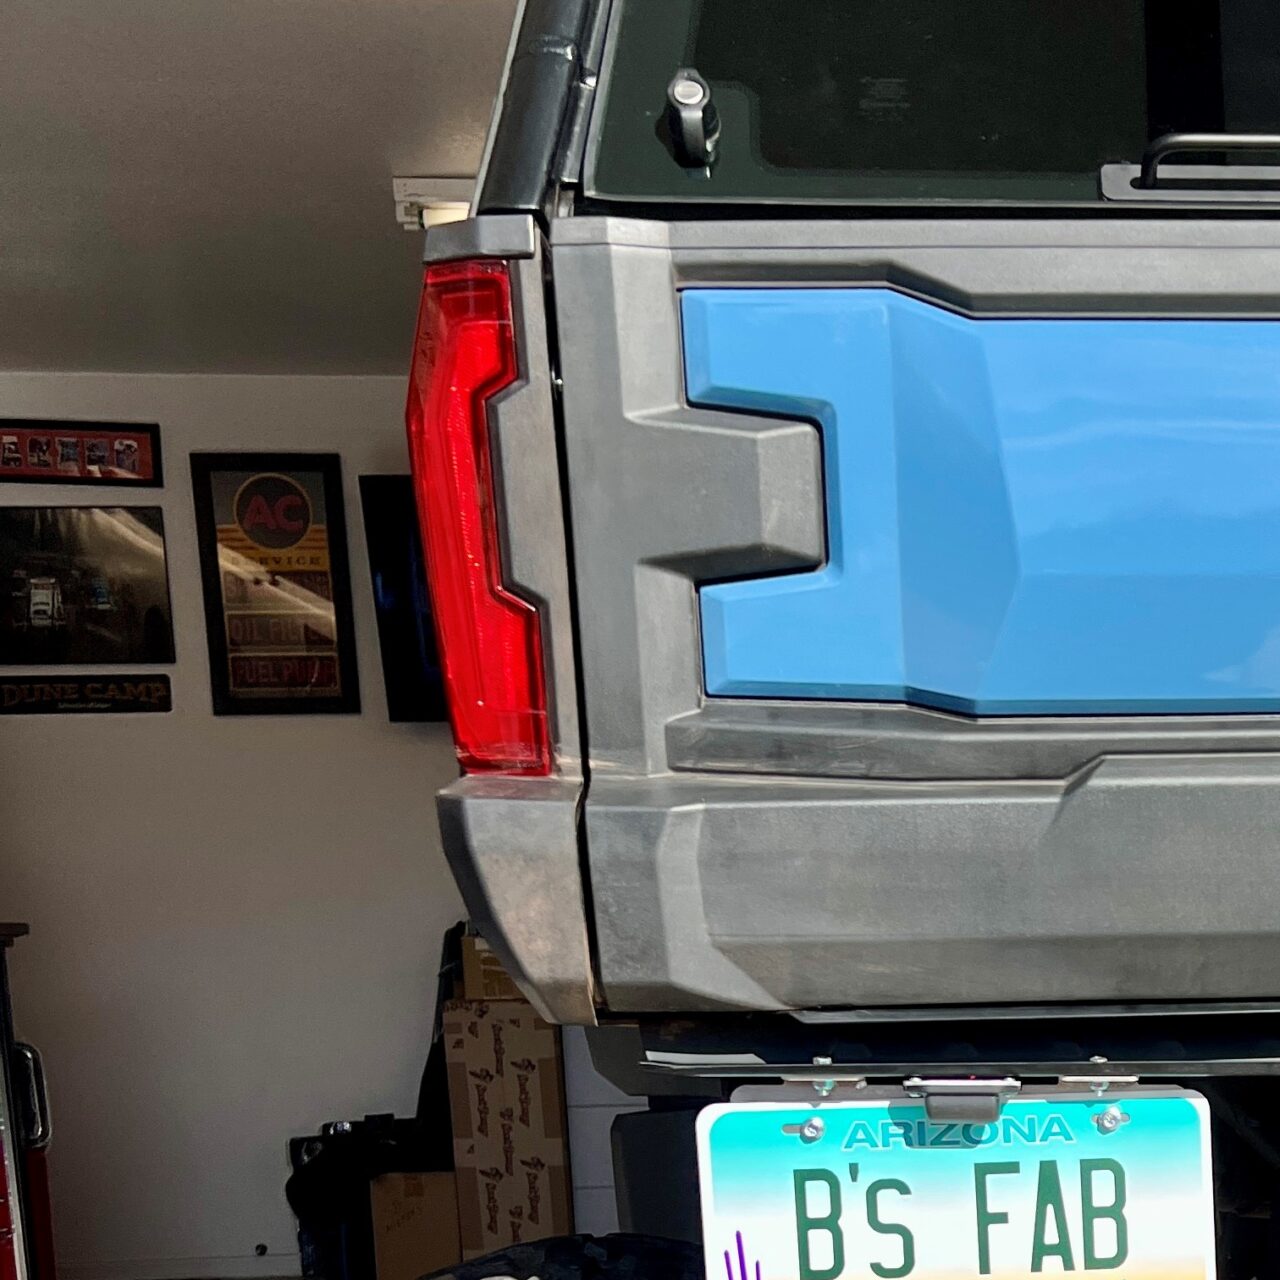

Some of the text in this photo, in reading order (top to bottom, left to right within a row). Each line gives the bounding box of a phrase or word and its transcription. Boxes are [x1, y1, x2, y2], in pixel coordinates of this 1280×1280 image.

[243, 494, 303, 533] AC
[232, 555, 321, 566] SRVICE
[236, 660, 279, 683] FUEL
[1, 683, 166, 706] DUNE CAMP
[842, 1113, 1076, 1151] ARIZONA
[974, 1157, 1129, 1274] FAB
